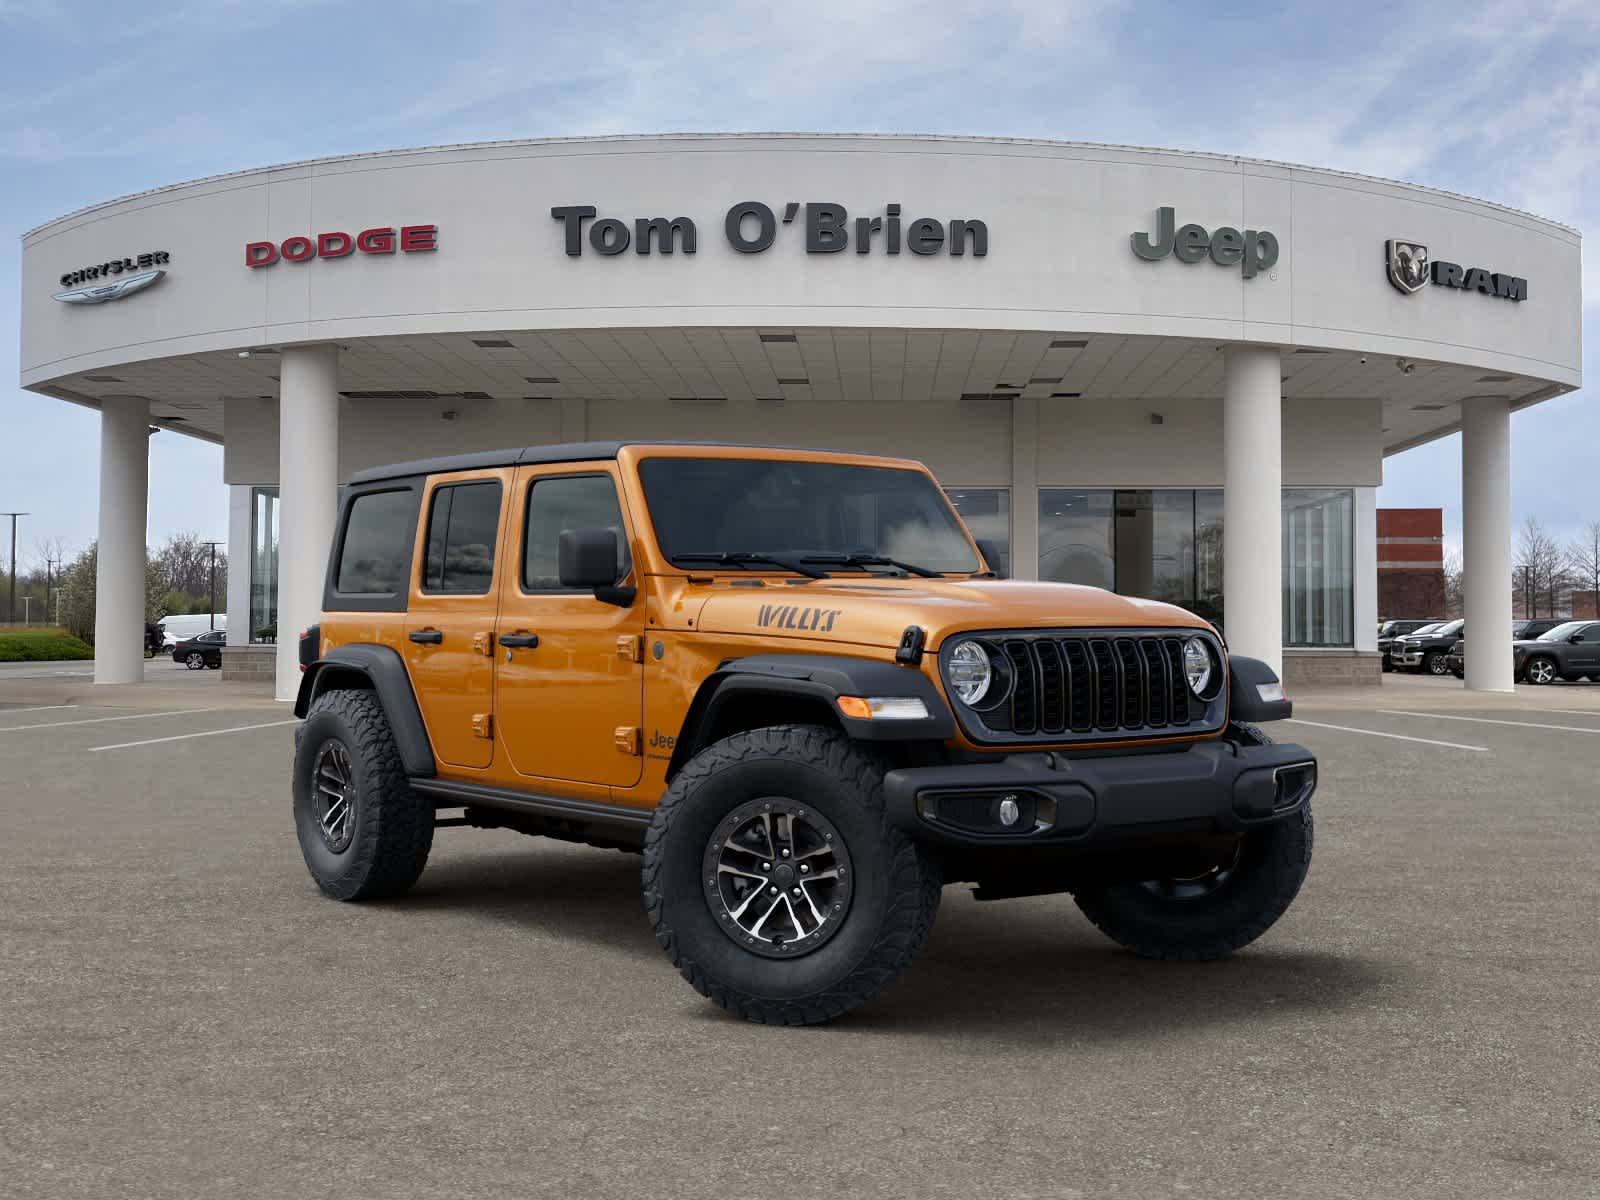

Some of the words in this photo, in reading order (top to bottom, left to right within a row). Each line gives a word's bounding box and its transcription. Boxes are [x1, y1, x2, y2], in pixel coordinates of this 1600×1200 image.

[246, 225, 438, 268] DODGE
[551, 205, 697, 257] Tom
[1131, 206, 1279, 279] Jeep
[60, 250, 169, 287] CHRYSLER
[1431, 260, 1528, 301] RAM
[757, 604, 842, 632] WILLYS
[649, 729, 679, 749] Jee
